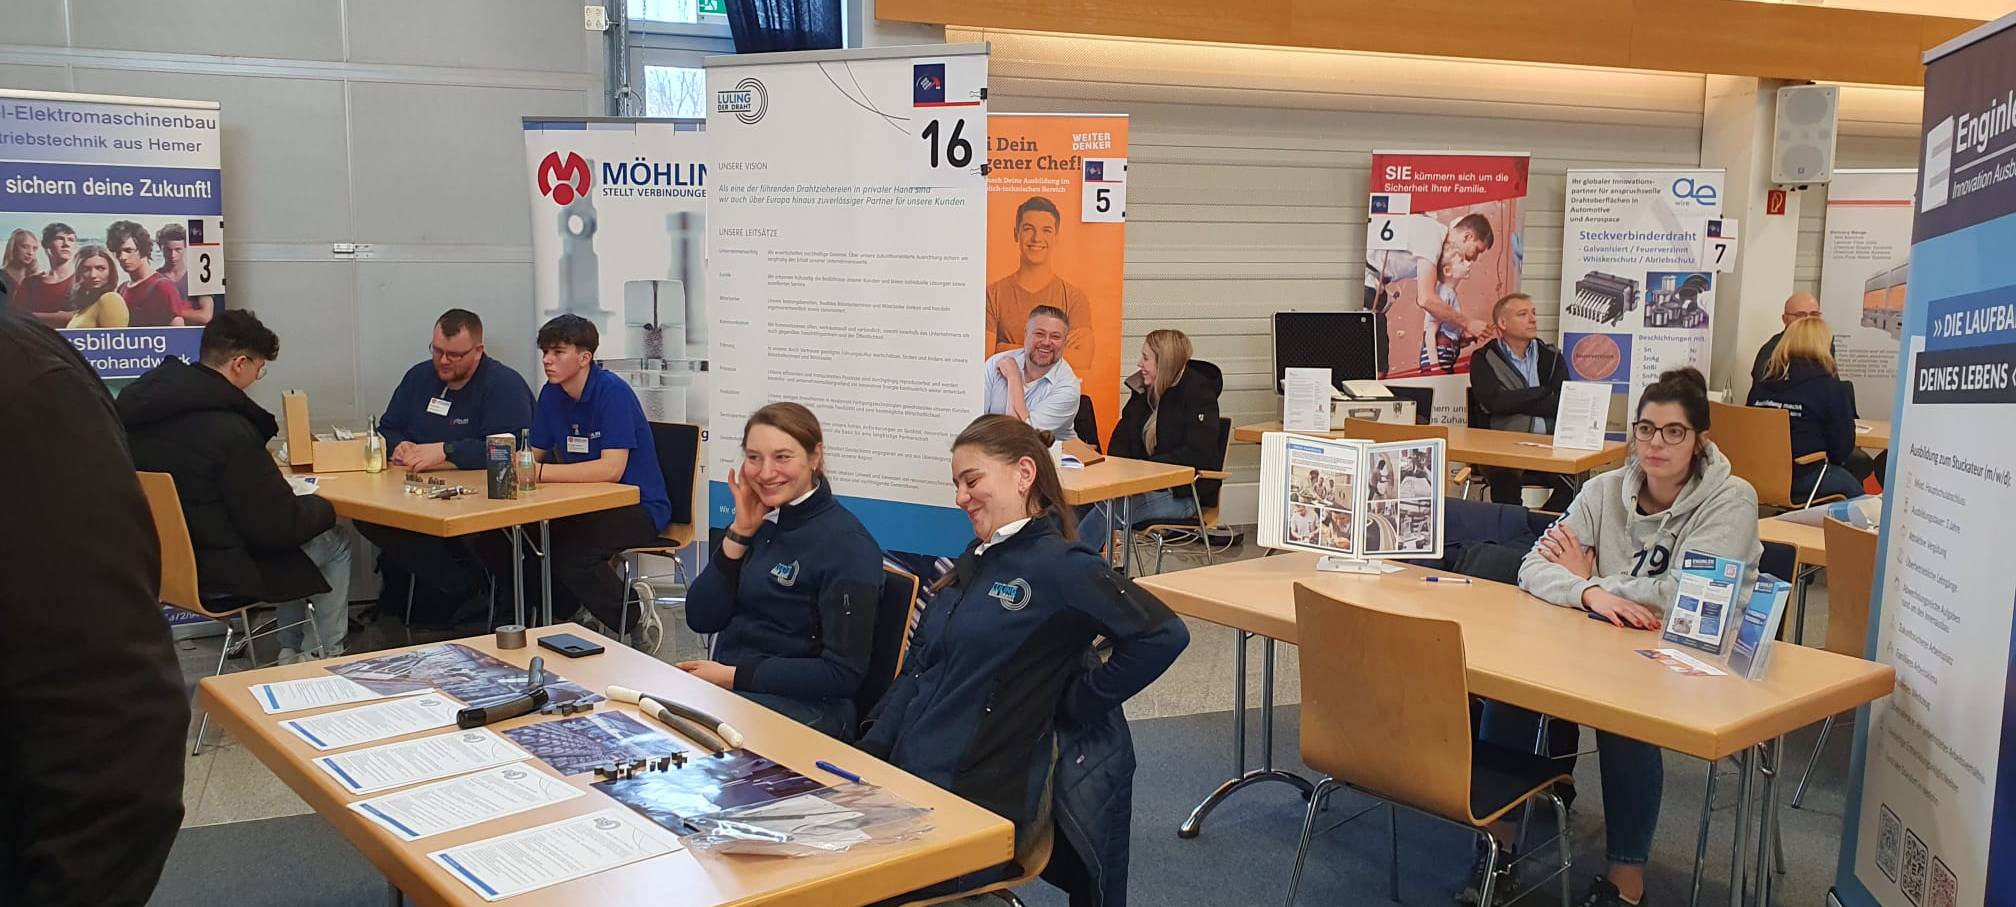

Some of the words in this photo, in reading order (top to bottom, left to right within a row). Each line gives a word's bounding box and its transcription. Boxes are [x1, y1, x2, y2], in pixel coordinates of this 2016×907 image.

[718, 92, 751, 104] LULING
[921, 119, 972, 168] 16
[997, 136, 1038, 151] Dein
[1072, 132, 1110, 142] WEITER
[114, 138, 143, 150] aus
[149, 138, 202, 153] Hemer
[1072, 141, 1111, 151] DENKER
[718, 162, 743, 170] UNSERE
[746, 162, 768, 170] VISION
[1037, 155, 1082, 170] Chef!
[1385, 165, 1412, 180] SIE
[1414, 172, 1455, 181] kümmern
[1458, 172, 1476, 181] sich
[1479, 174, 1492, 182] um
[1495, 173, 1509, 182] die
[1952, 171, 1992, 199] Innovation
[1993, 157, 2016, 184] Ausb
[6, 175, 76, 196] sichern
[83, 177, 133, 196] deine
[139, 178, 212, 198] Zukunft!
[718, 184, 728, 193] Als
[747, 184, 758, 193] der
[760, 184, 795, 194] führenden
[796, 185, 852, 194] Drahtziehereien
[1385, 183, 1428, 192] Sicherheit
[1431, 183, 1451, 193] Ihrer
[1454, 184, 1486, 193] Familie.
[1583, 178, 1610, 186] globaler
[602, 187, 634, 197] STELLT
[1571, 187, 1597, 196] partner
[1610, 188, 1661, 196] anspruchsvolle
[766, 196, 790, 206] Europa
[792, 196, 815, 205] hinaus
[866, 197, 893, 205] Partner
[907, 198, 932, 206] unsere
[934, 197, 965, 206] Kunden
[1096, 188, 1111, 213] 5
[719, 229, 743, 237] UNSERE
[745, 227, 778, 237] LEITSÄTZE
[1380, 220, 1394, 241] 6
[1579, 230, 1697, 241] Steckverbinderdraht
[1583, 246, 1628, 254] Galvanisiert
[1715, 244, 1726, 264] 7
[1583, 256, 1637, 264] Whiskerschutz
[199, 253, 211, 283] 3
[1965, 304, 2016, 335] LAUFBA
[69, 333, 166, 352] sbildung
[1638, 334, 1692, 343] Beschichtungen
[1919, 366, 1960, 391] DEINES
[1961, 363, 2009, 390] LEBENS
[1910, 443, 1938, 466] Ausbildung
[1939, 452, 1951, 467] zum
[1952, 455, 1984, 477] Stuckateur
[1631, 544, 1669, 577] 19
